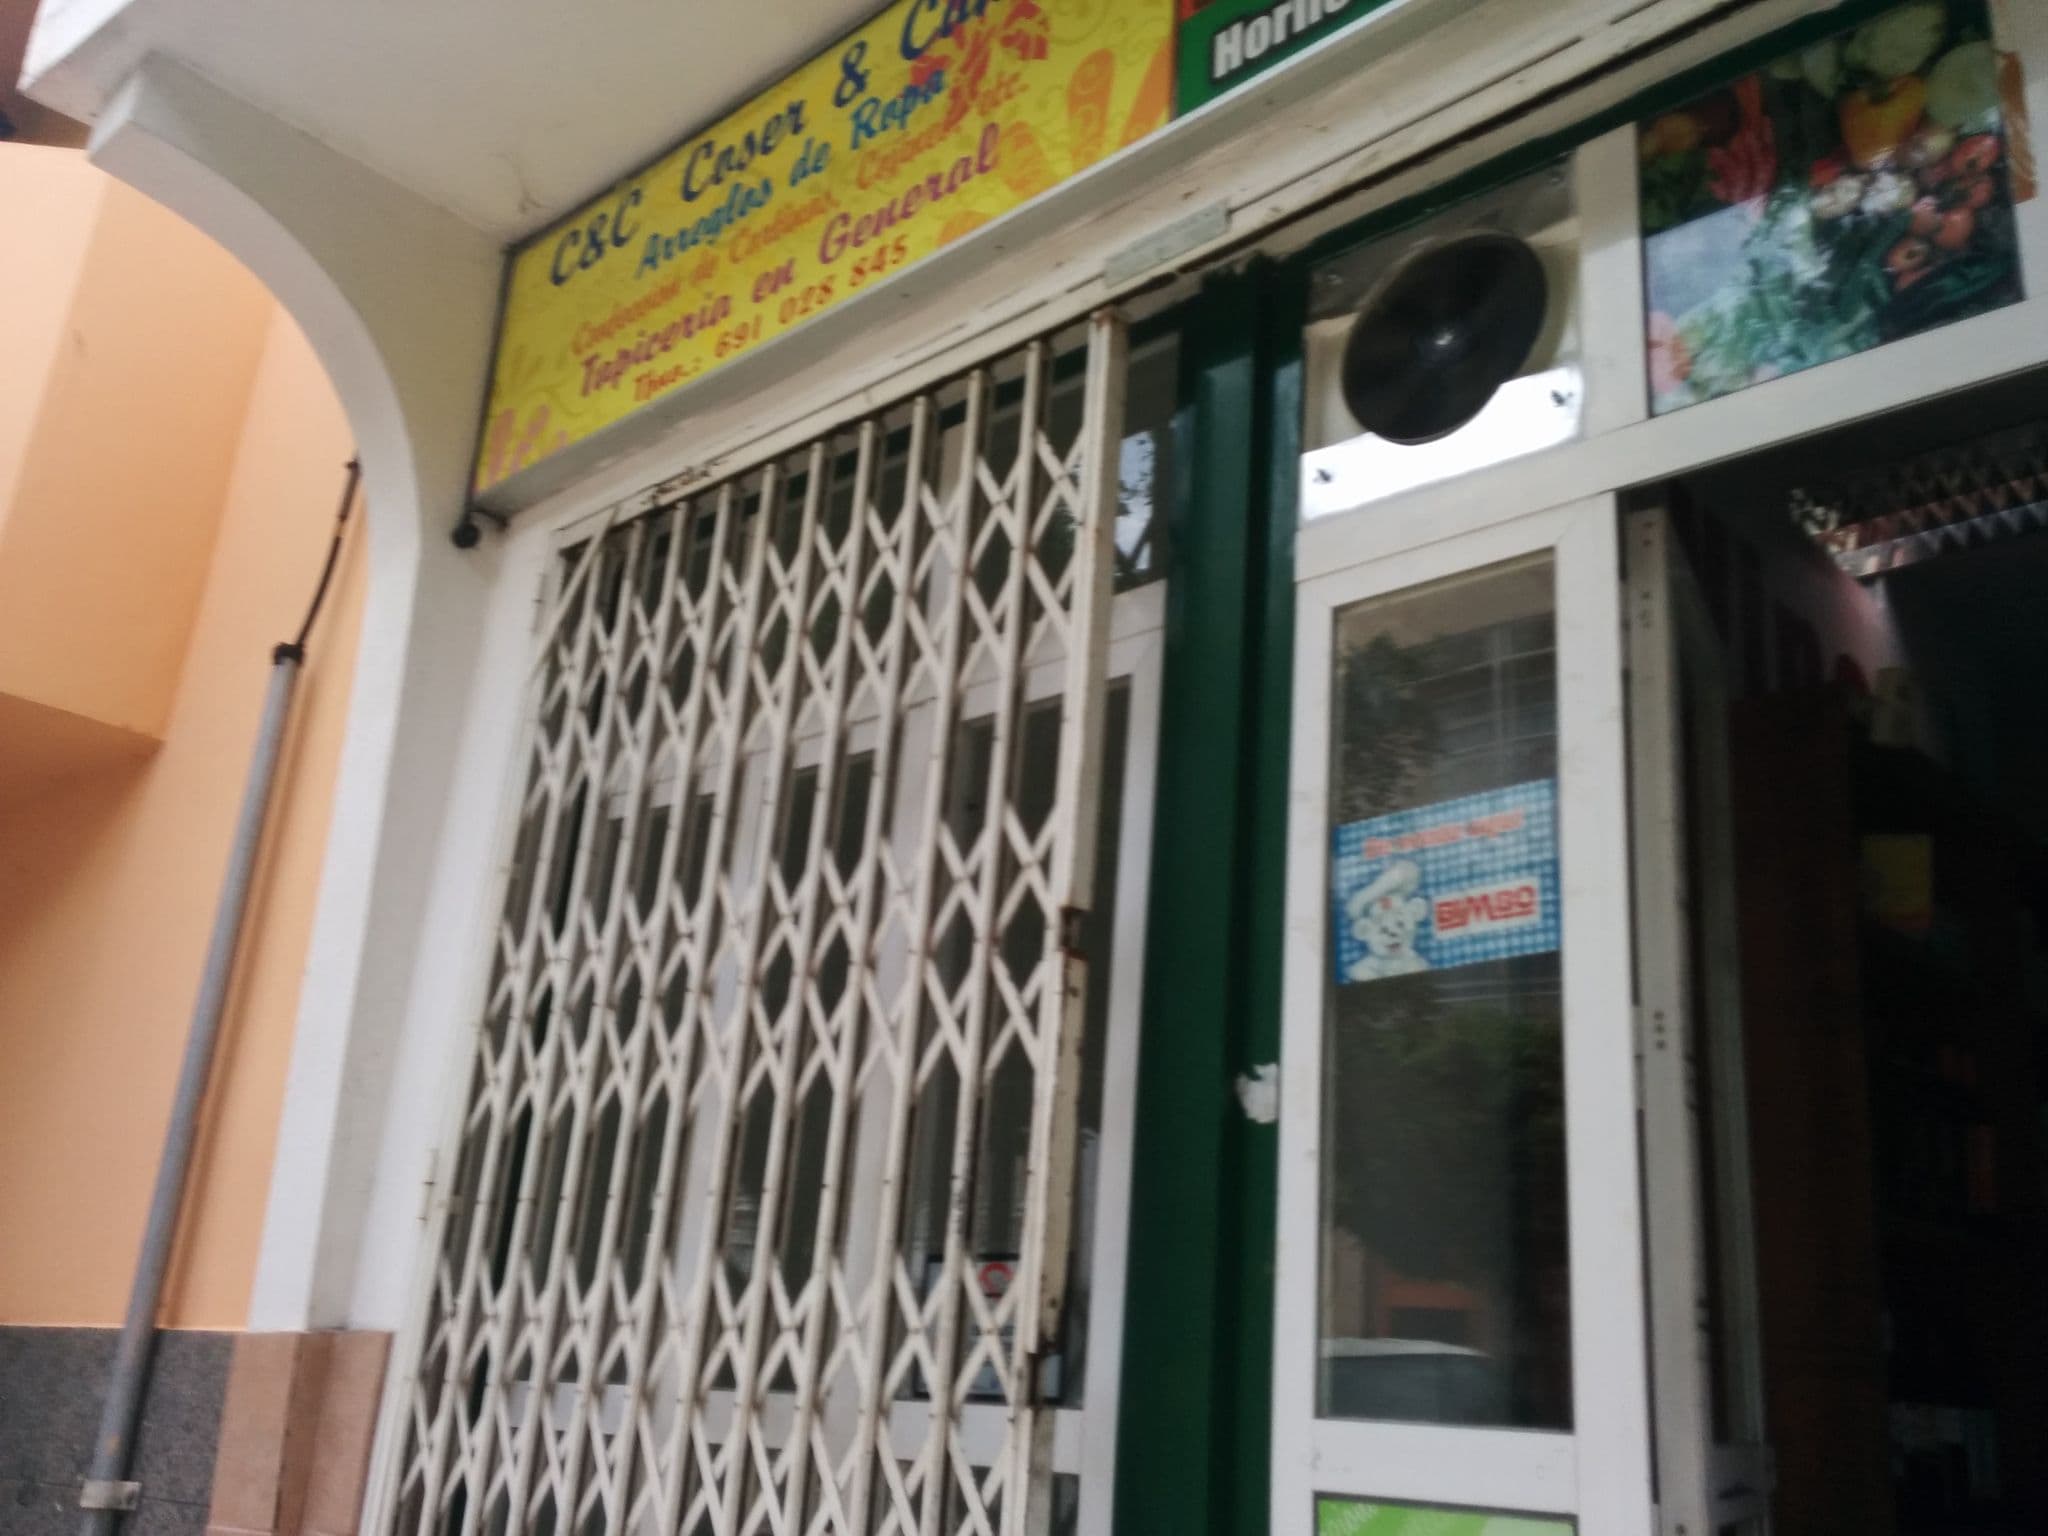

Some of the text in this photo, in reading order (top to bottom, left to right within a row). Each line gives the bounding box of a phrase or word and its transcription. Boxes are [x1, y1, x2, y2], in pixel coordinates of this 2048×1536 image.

[550, 188, 643, 287] C&C
[682, 100, 807, 202] Coser
[834, 41, 870, 107] &
[635, 70, 945, 277] Arreglos de Ropa
[752, 258, 796, 303] en
[819, 122, 1000, 265] General
[715, 314, 762, 358] 691
[779, 274, 837, 324] 028
[849, 234, 909, 288] 845
[1435, 884, 1535, 930] BIMBO
